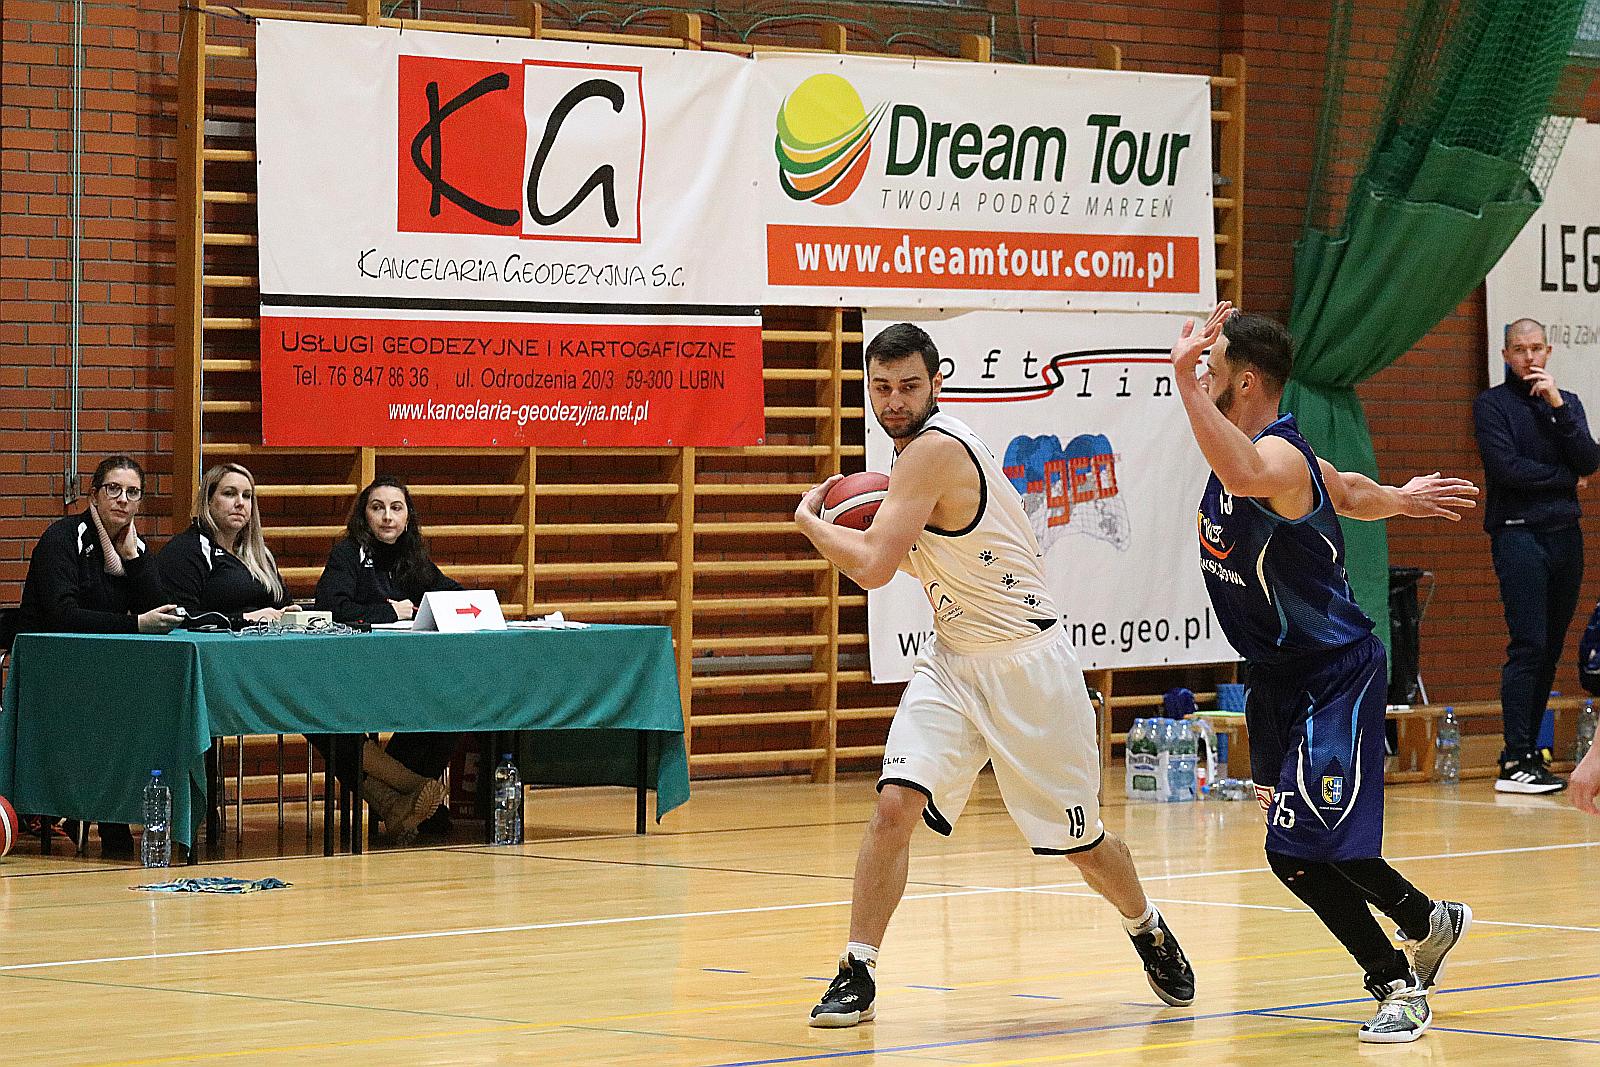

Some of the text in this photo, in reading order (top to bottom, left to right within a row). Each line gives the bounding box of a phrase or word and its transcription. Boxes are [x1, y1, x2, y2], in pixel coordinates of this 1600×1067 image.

[410, 72, 625, 228] KG
[885, 104, 1191, 187] Dream Tour
[881, 189, 1174, 218] TWOJA PODRÓŻ MARZEŃ
[652, 264, 685, 287] S.C.
[796, 235, 1175, 288] www.dreamtour.com.pl
[281, 330, 736, 359] USŁUGI GEODEZYJNE I KARTOGAFICZNE
[293, 365, 321, 386] Tel.
[328, 365, 347, 386] 76
[353, 366, 384, 387] 847
[389, 367, 405, 388] 86
[456, 368, 474, 388] ul.
[482, 368, 576, 389] Odrodzenia
[582, 369, 614, 390] 20/3
[625, 369, 673, 390] 59-300
[680, 369, 725, 390] LUBIN
[939, 349, 1172, 398] oft lin
[389, 398, 649, 427] www.kancelaria-geodezyjna.net.pl
[883, 757, 907, 766] ELME
[1065, 805, 1086, 839] 19
[1273, 791, 1295, 829] 15
